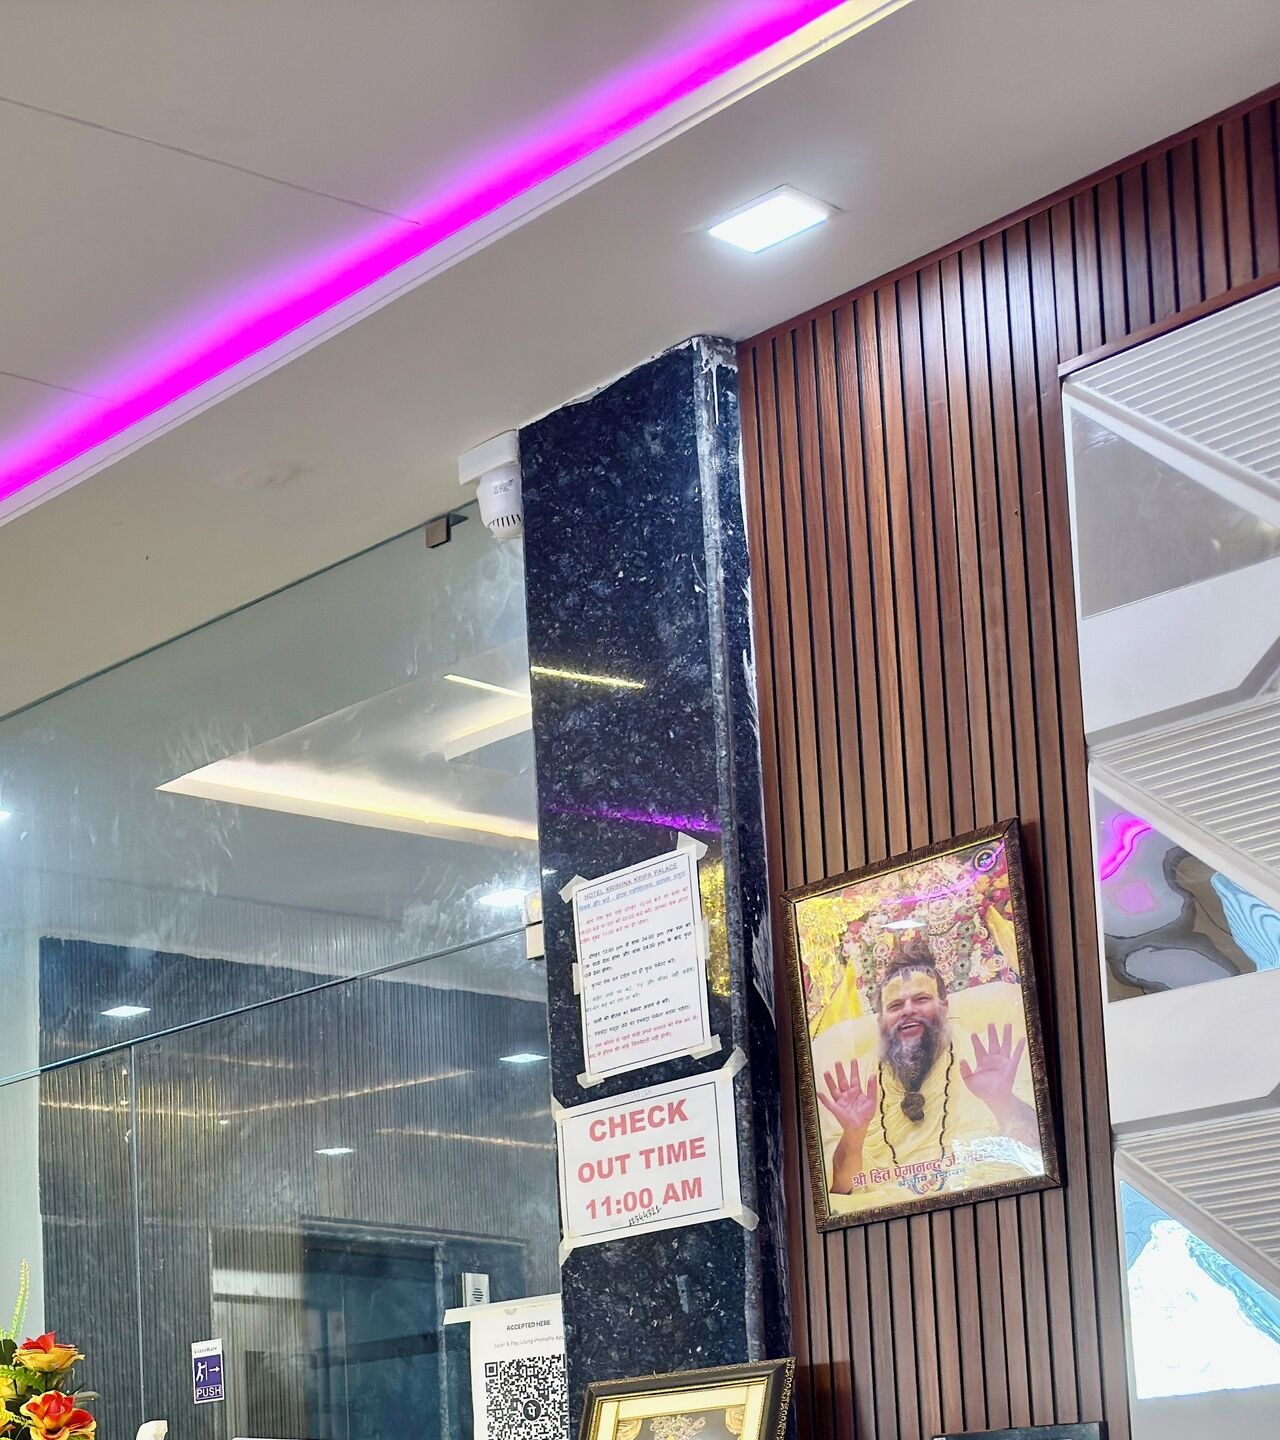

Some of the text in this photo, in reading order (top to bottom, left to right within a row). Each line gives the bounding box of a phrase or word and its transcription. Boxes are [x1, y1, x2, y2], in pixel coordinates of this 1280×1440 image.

[584, 888, 604, 900] HOTEL
[606, 879, 632, 893] KRISHNA
[654, 864, 678, 877] PALACE
[589, 1099, 689, 1142] CHECK
[577, 1136, 706, 1184] OUT TIME
[852, 1172, 867, 1188] श्री
[870, 1168, 891, 1184] हित
[585, 1176, 703, 1220] 11:00 AM
[506, 1319, 551, 1331] ACCEPTED HERE
[196, 1386, 221, 1398] PUSH
